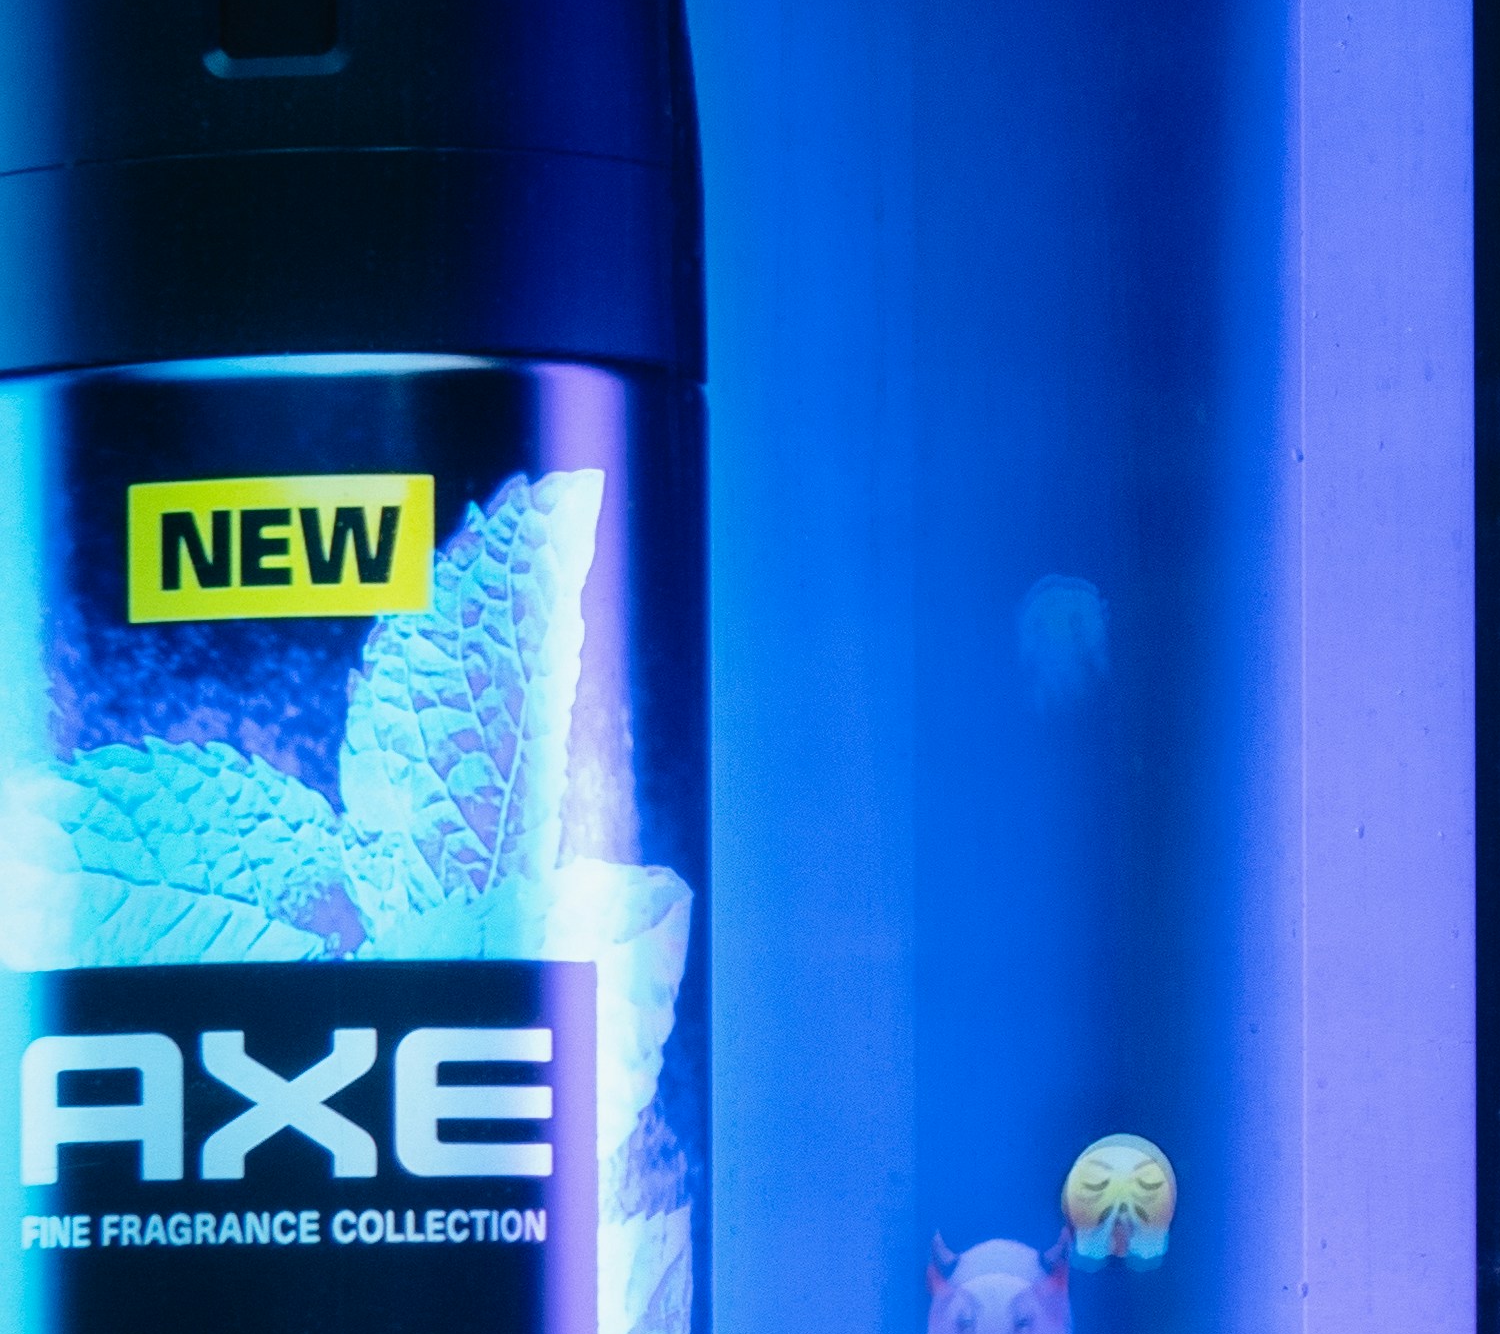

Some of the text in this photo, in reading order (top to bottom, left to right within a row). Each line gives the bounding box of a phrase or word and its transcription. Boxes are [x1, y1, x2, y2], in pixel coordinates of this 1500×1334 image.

[160, 505, 402, 592] NEW
[20, 1027, 554, 1185] AXE
[21, 1209, 548, 1250] FINE FRAGRANCE COLLECTION
